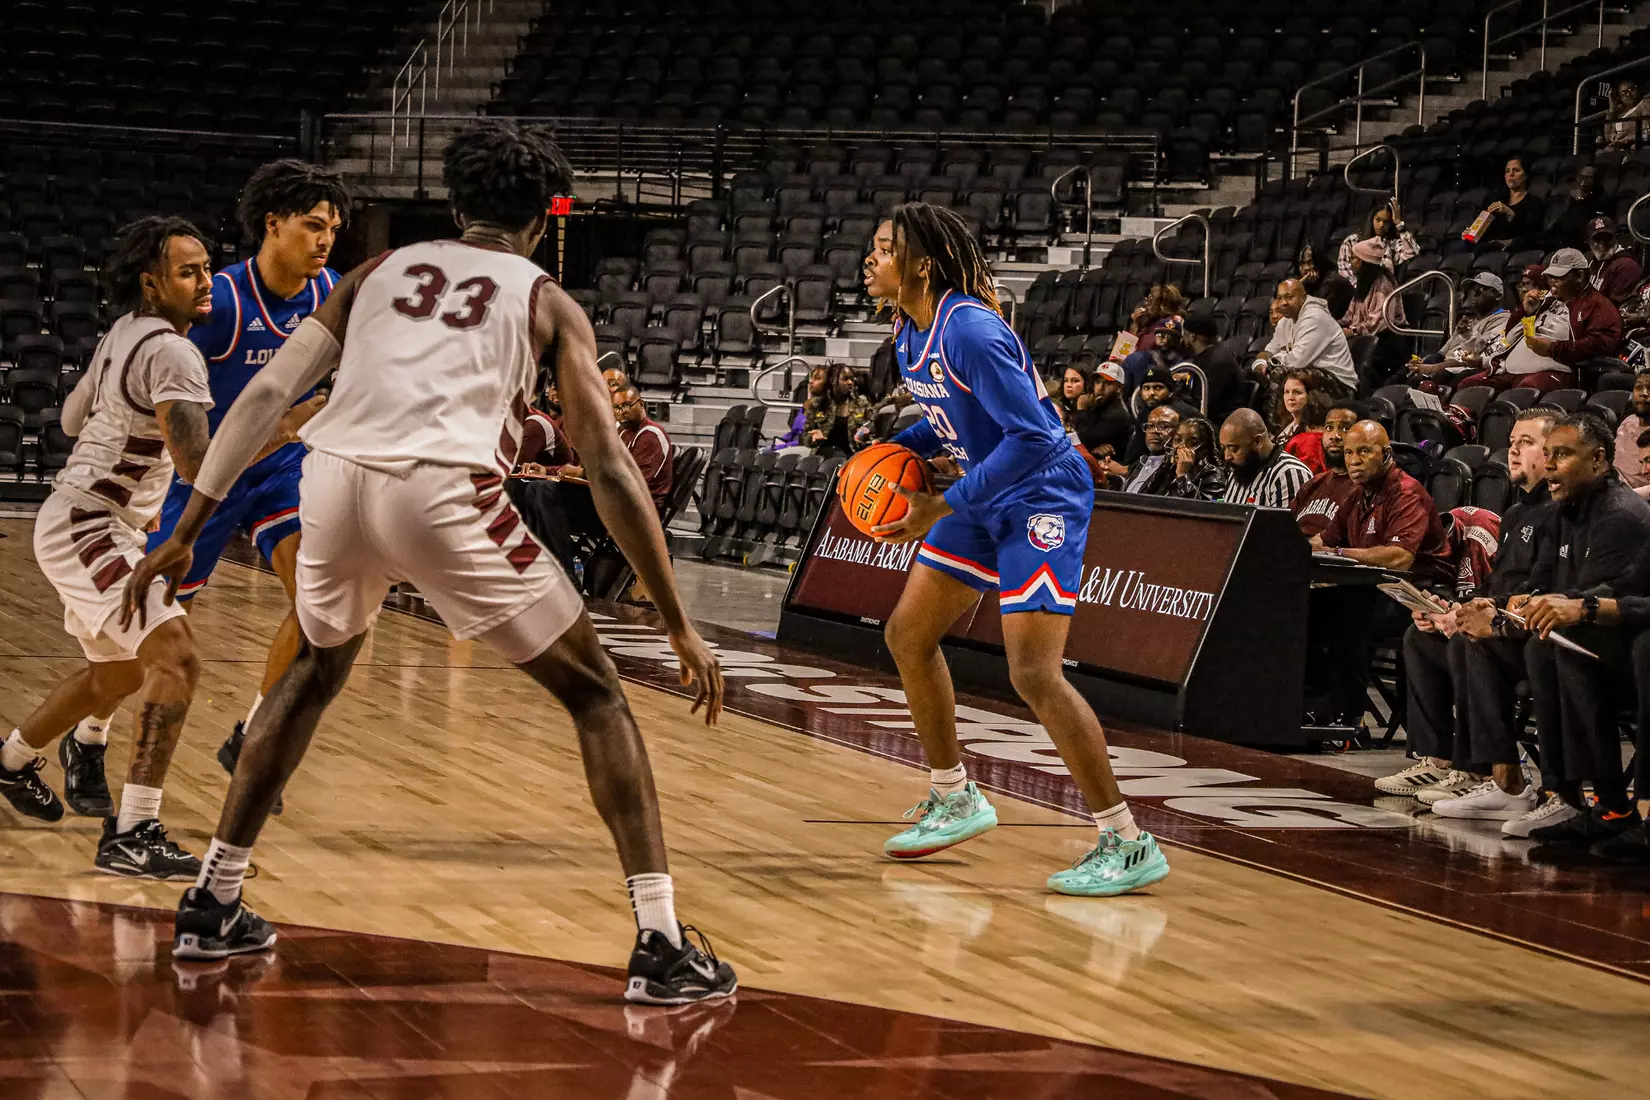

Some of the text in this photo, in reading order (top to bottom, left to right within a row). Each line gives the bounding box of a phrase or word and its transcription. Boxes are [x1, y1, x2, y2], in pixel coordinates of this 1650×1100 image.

[391, 263, 500, 331] 33
[902, 376, 950, 398] OUISIANA
[919, 401, 958, 441] 20
[856, 473, 887, 521] ELITE
[814, 527, 920, 572] ALABAMA A&M
[1076, 564, 1215, 621] &M UNIVERSITY
